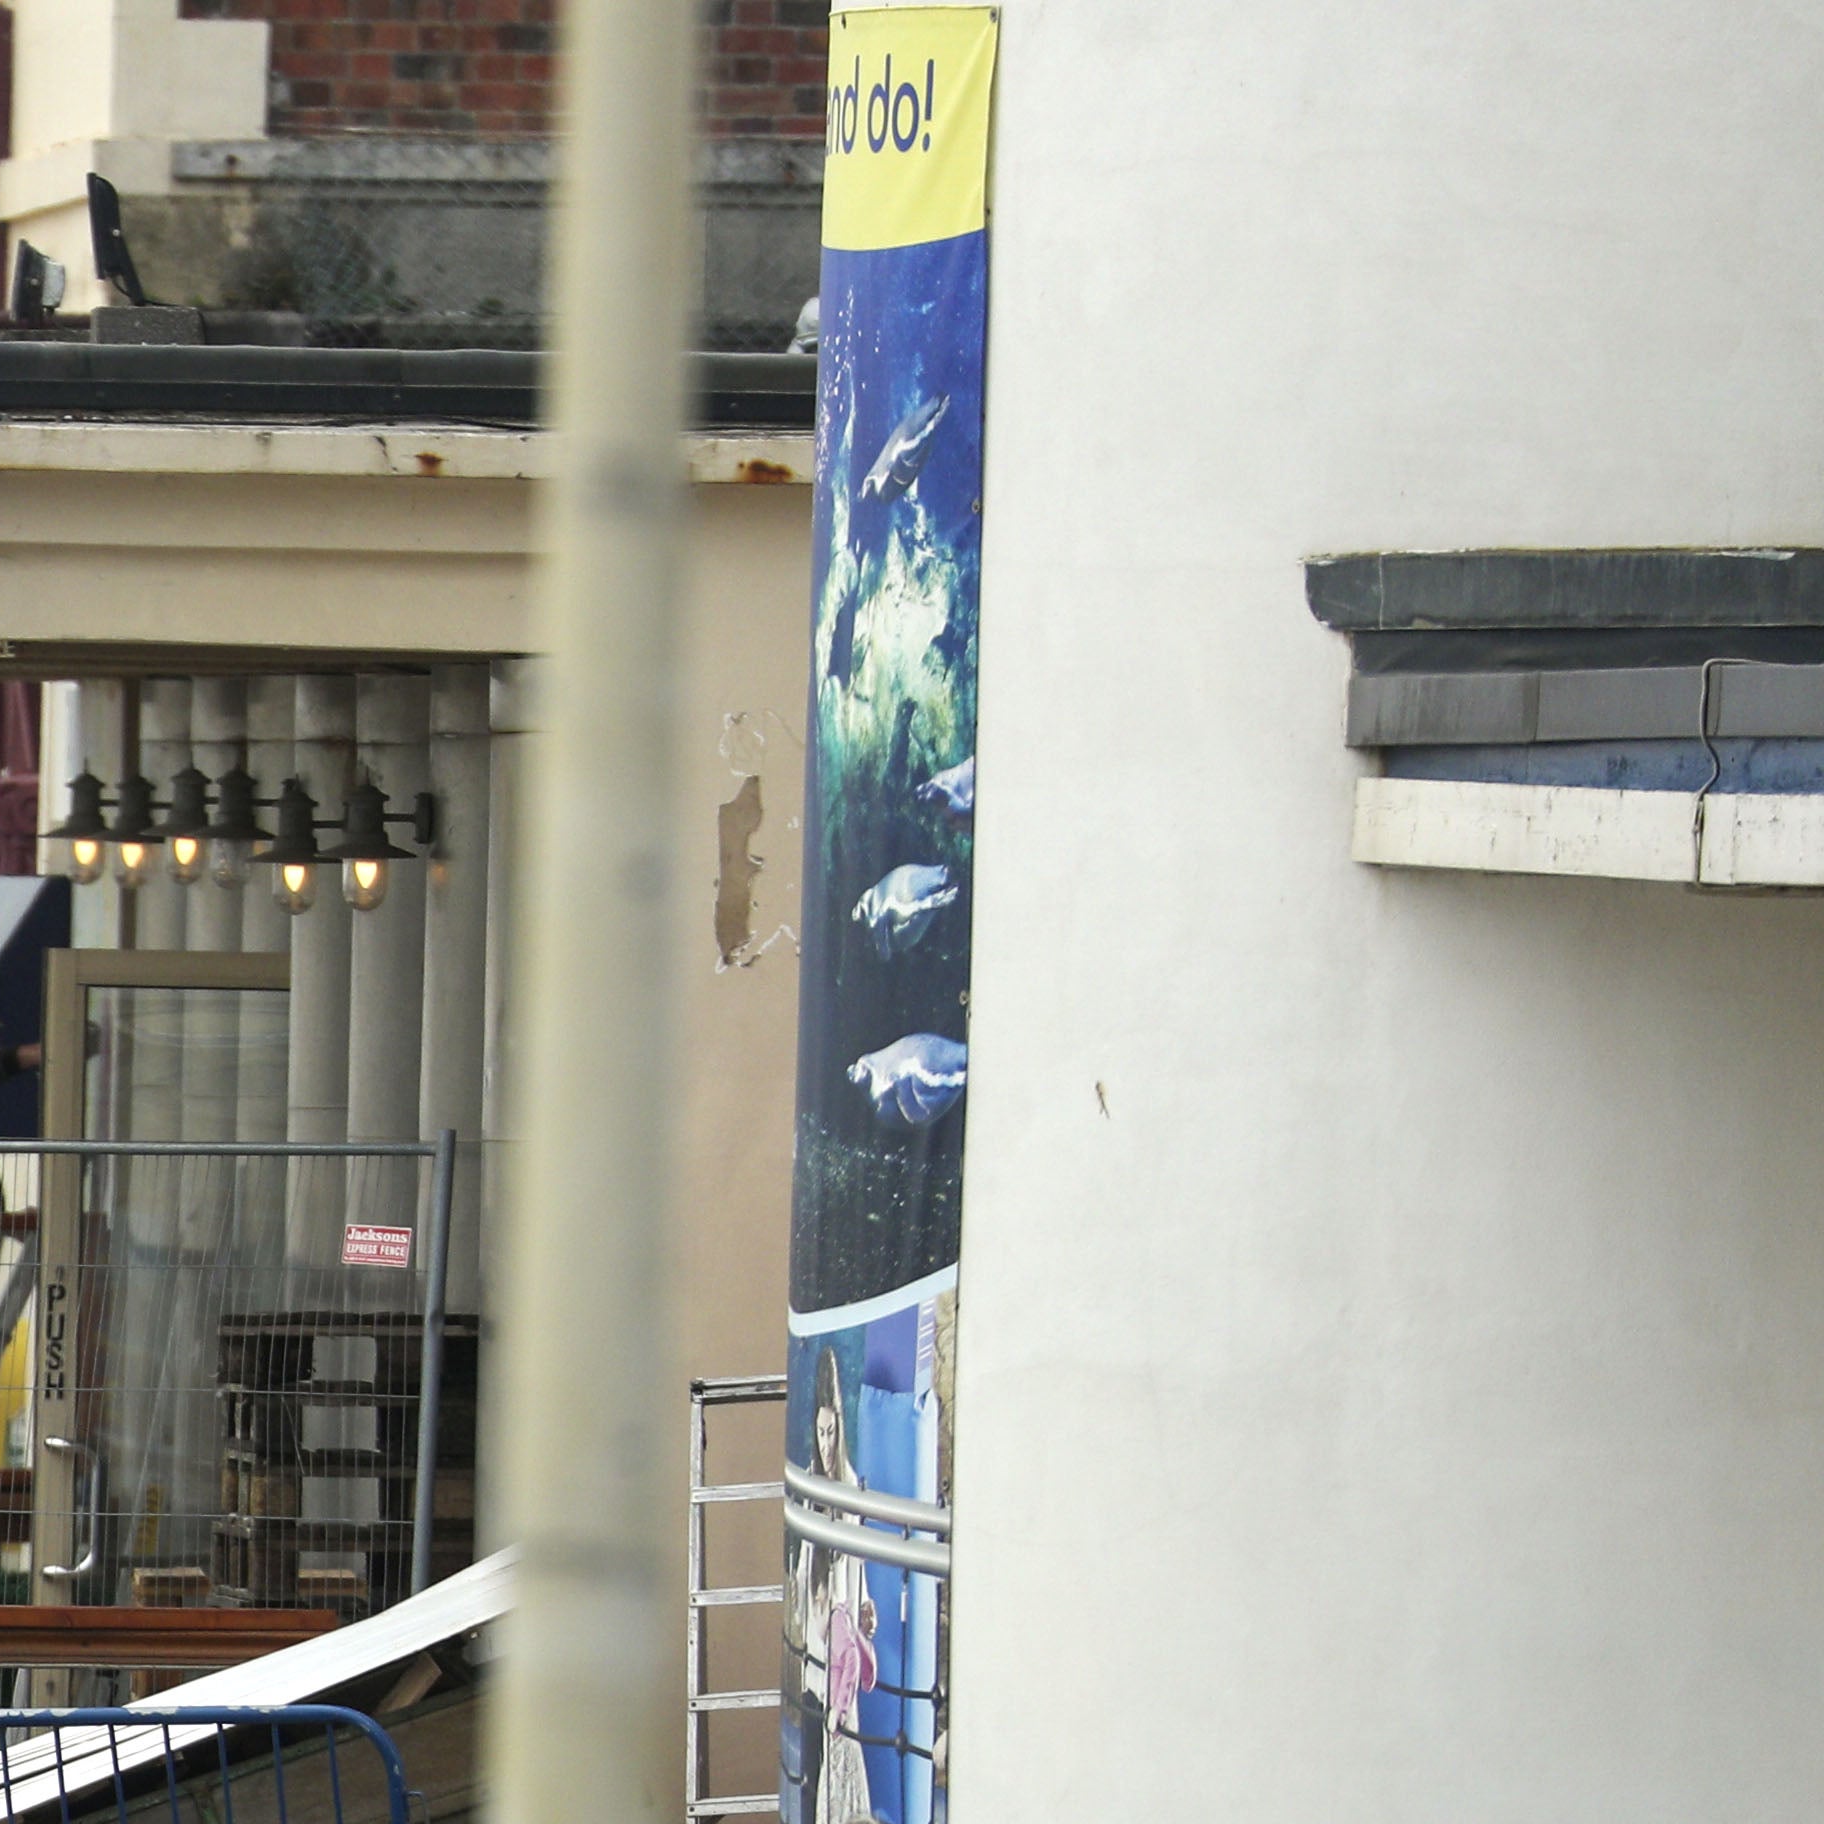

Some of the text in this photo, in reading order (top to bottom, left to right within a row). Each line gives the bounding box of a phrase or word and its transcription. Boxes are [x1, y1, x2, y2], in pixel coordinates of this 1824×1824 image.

[867, 53, 934, 154] do!
[347, 1227, 408, 1244] Jacksons
[380, 1244, 404, 1257] FENCE
[45, 1283, 66, 1400] PUSH
